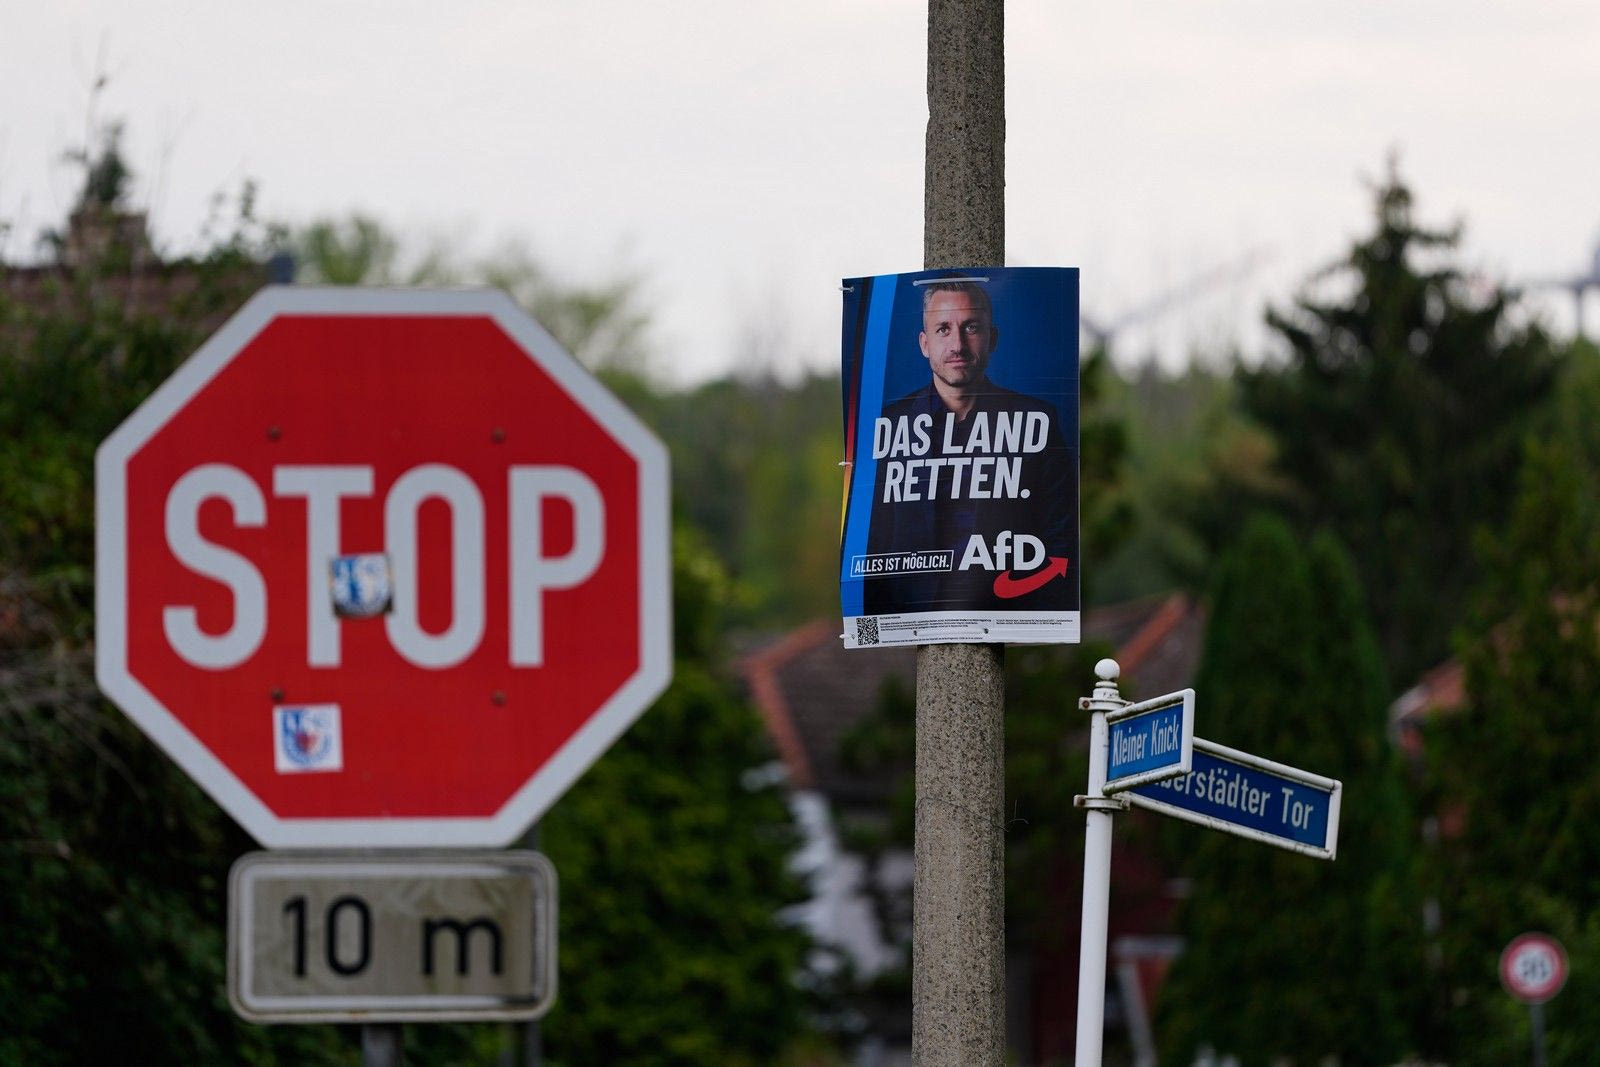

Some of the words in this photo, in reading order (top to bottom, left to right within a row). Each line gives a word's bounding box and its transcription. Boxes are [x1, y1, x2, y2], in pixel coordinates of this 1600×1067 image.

[872, 413, 933, 459] DAS
[942, 411, 1050, 454] LAND
[883, 457, 1031, 503] RETTEN.
[162, 462, 606, 672] STOP
[854, 558, 884, 573] ALLES
[885, 556, 901, 571] IST
[902, 553, 950, 569] MÖGLICH.
[958, 530, 1046, 571] AfD
[1112, 727, 1147, 767] Kleiner
[1151, 714, 1179, 757] Knick
[1154, 767, 1271, 817] erstädter
[1282, 786, 1314, 830] Tor
[283, 894, 373, 979] 10
[421, 917, 504, 977] m
